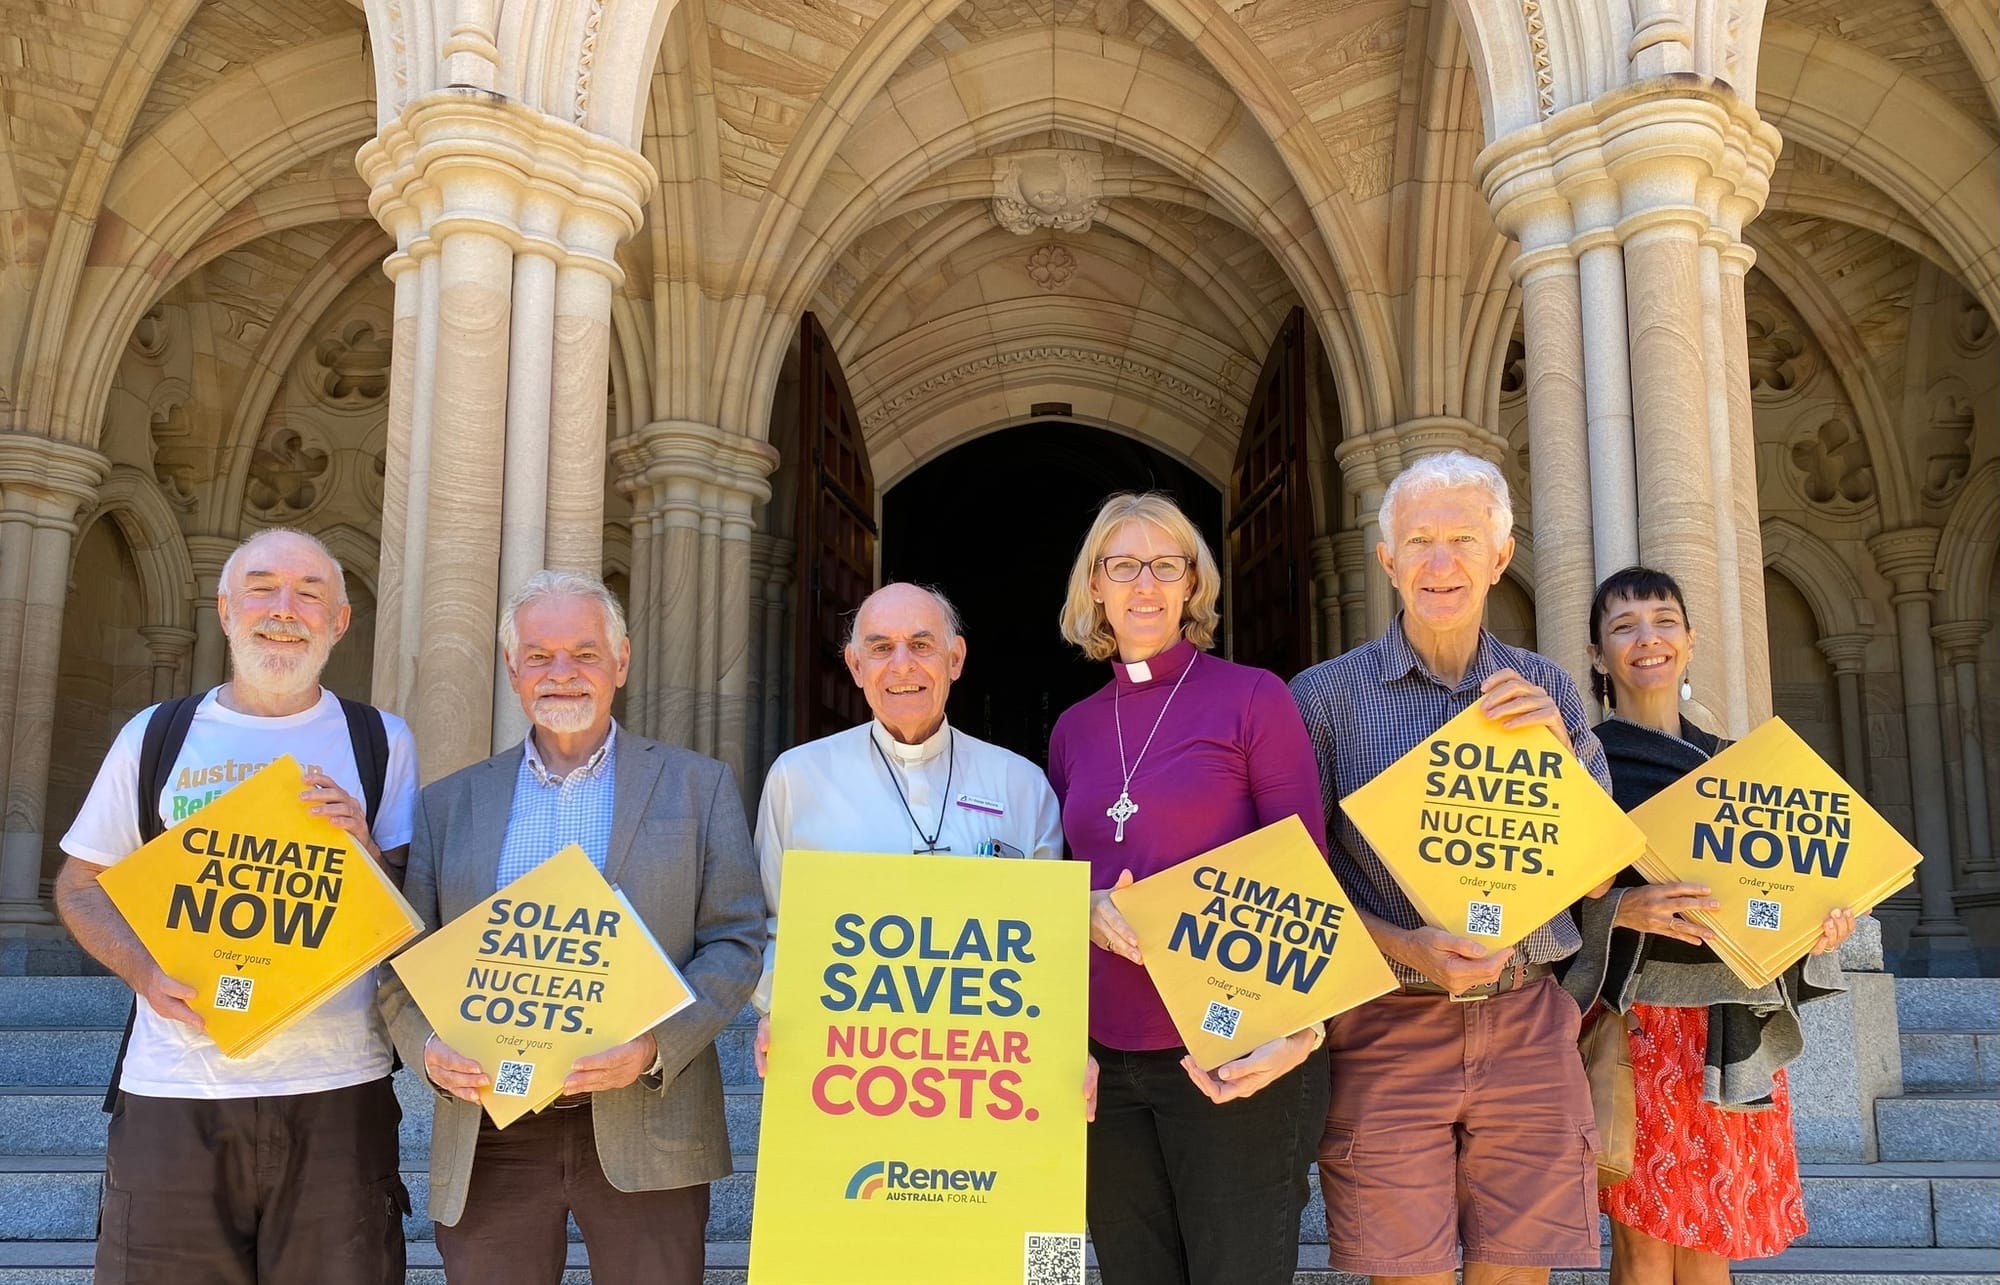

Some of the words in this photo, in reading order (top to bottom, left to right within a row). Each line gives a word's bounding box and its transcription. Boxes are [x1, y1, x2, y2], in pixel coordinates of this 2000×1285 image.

[1429, 740, 1563, 780] SOLAR
[1425, 771, 1560, 810] SAVES.
[1695, 776, 1850, 816] CLIMATE
[1420, 809, 1559, 845] NUCLEAR
[1713, 802, 1851, 840] ACTION
[182, 827, 347, 875] CLIMATE
[1418, 836, 1554, 877] COSTS.
[1691, 821, 1850, 879] NOW
[195, 859, 343, 904] ACTION
[1192, 866, 1345, 931] CLIMATE
[1460, 876, 1487, 887] Order
[1490, 881, 1517, 891] yours
[1739, 876, 1766, 888] Order
[1768, 882, 1795, 892] yours
[165, 883, 337, 949] NOW
[487, 898, 621, 938] SOLAR
[1199, 895, 1339, 956] ACTION
[213, 949, 242, 961] Order
[243, 954, 272, 966] yours
[478, 929, 610, 968] SAVES.
[831, 913, 1036, 964] SOLAR
[1167, 911, 1331, 995] NOW
[466, 967, 605, 1004] NUCLEAR
[819, 962, 1041, 1018] SAVES.
[1207, 976, 1233, 991] Order
[1234, 986, 1262, 1001] yours
[459, 994, 593, 1035] COSTS.
[496, 1034, 523, 1046] Order
[525, 1039, 553, 1050] yours
[826, 1025, 1032, 1064] NUCLEAR
[812, 1064, 1040, 1122] COSTS.
[887, 1161, 998, 1192] Renew
[886, 1192, 944, 1202] AUSTRALIA
[947, 1193, 968, 1203] FOR
[969, 1194, 987, 1204] ALL
